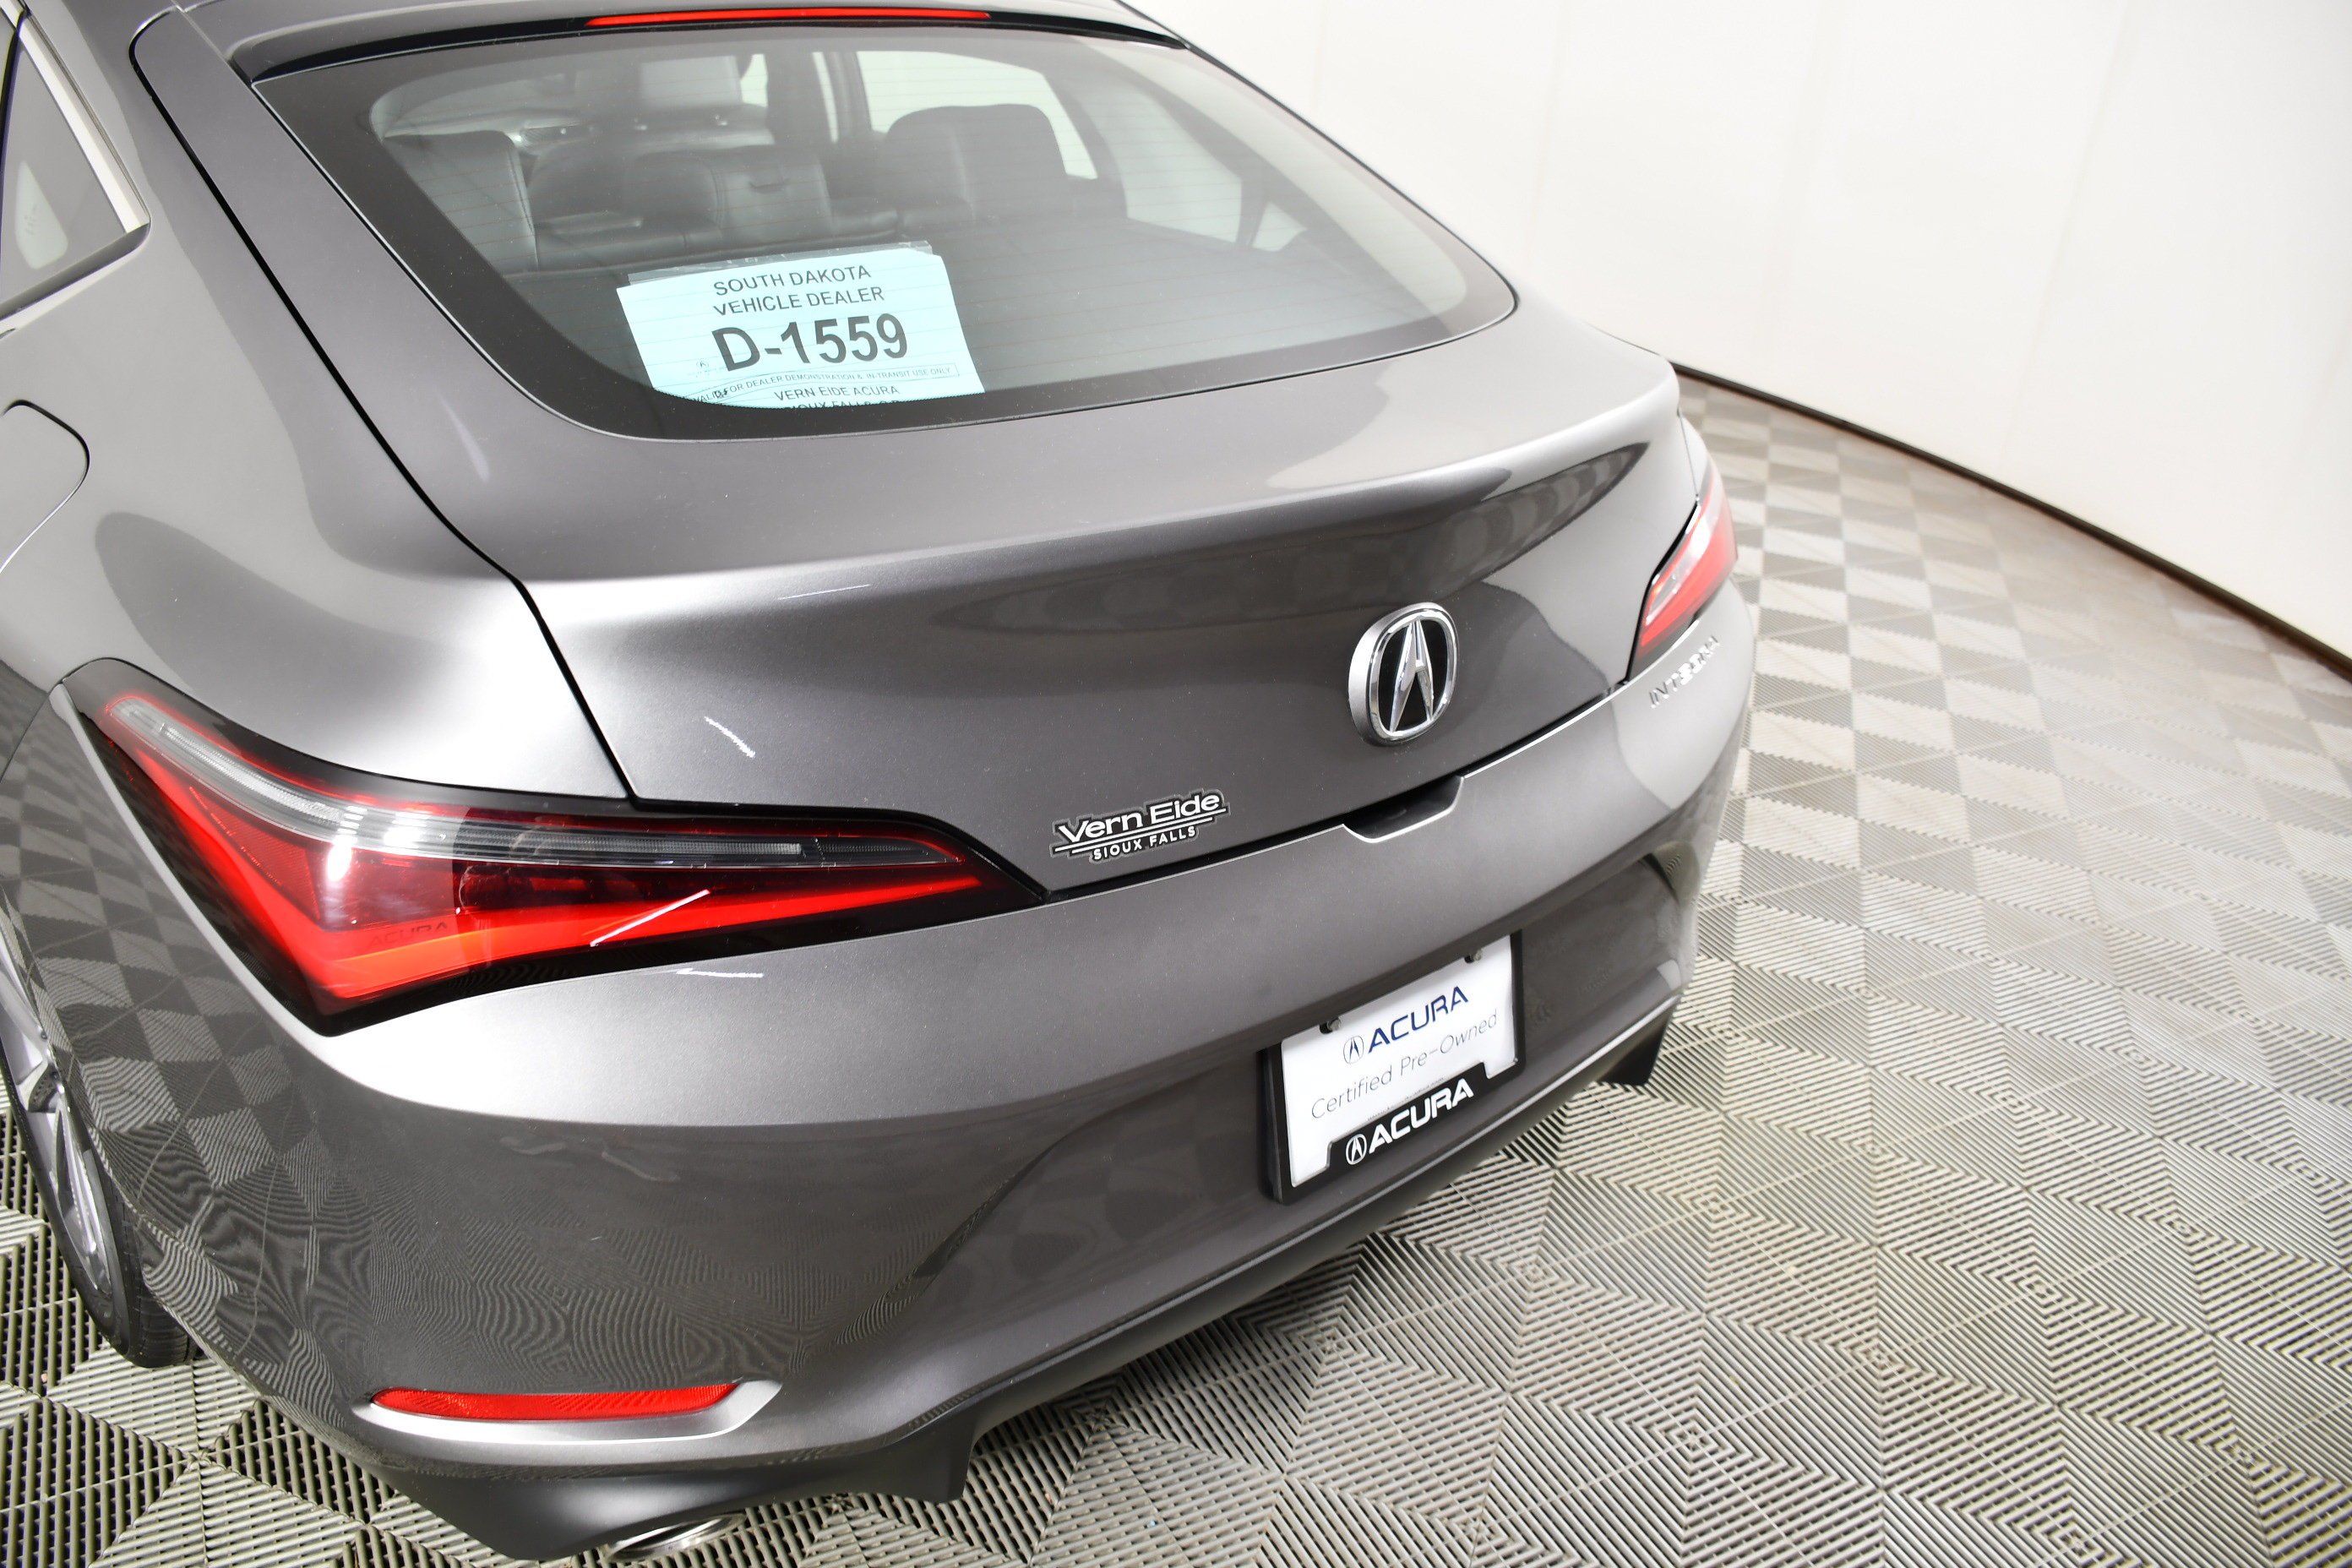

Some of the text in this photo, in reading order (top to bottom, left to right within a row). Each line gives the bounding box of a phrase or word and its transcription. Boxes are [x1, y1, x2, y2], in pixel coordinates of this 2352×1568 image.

[713, 264, 872, 296] SOUTH DAKOTA
[712, 286, 885, 316] VEHICLE DEALER
[711, 313, 908, 372] D-1559
[746, 375, 782, 389] DEALER
[785, 373, 856, 382] DEMONSTRATION
[866, 370, 910, 378] IN-TRANSIT
[930, 368, 950, 376] ONLY
[774, 385, 901, 401] VERN EIDE ACURA
[1059, 794, 1220, 843] Vern Eide
[1092, 825, 1196, 860] SIOUX FALLS
[368, 922, 448, 949] ACURA
[1368, 985, 1469, 1054] ACURA
[1311, 1064, 1392, 1119] Certified
[1400, 1009, 1497, 1076] Pre-Owned
[1369, 1078, 1474, 1154] ACURA
